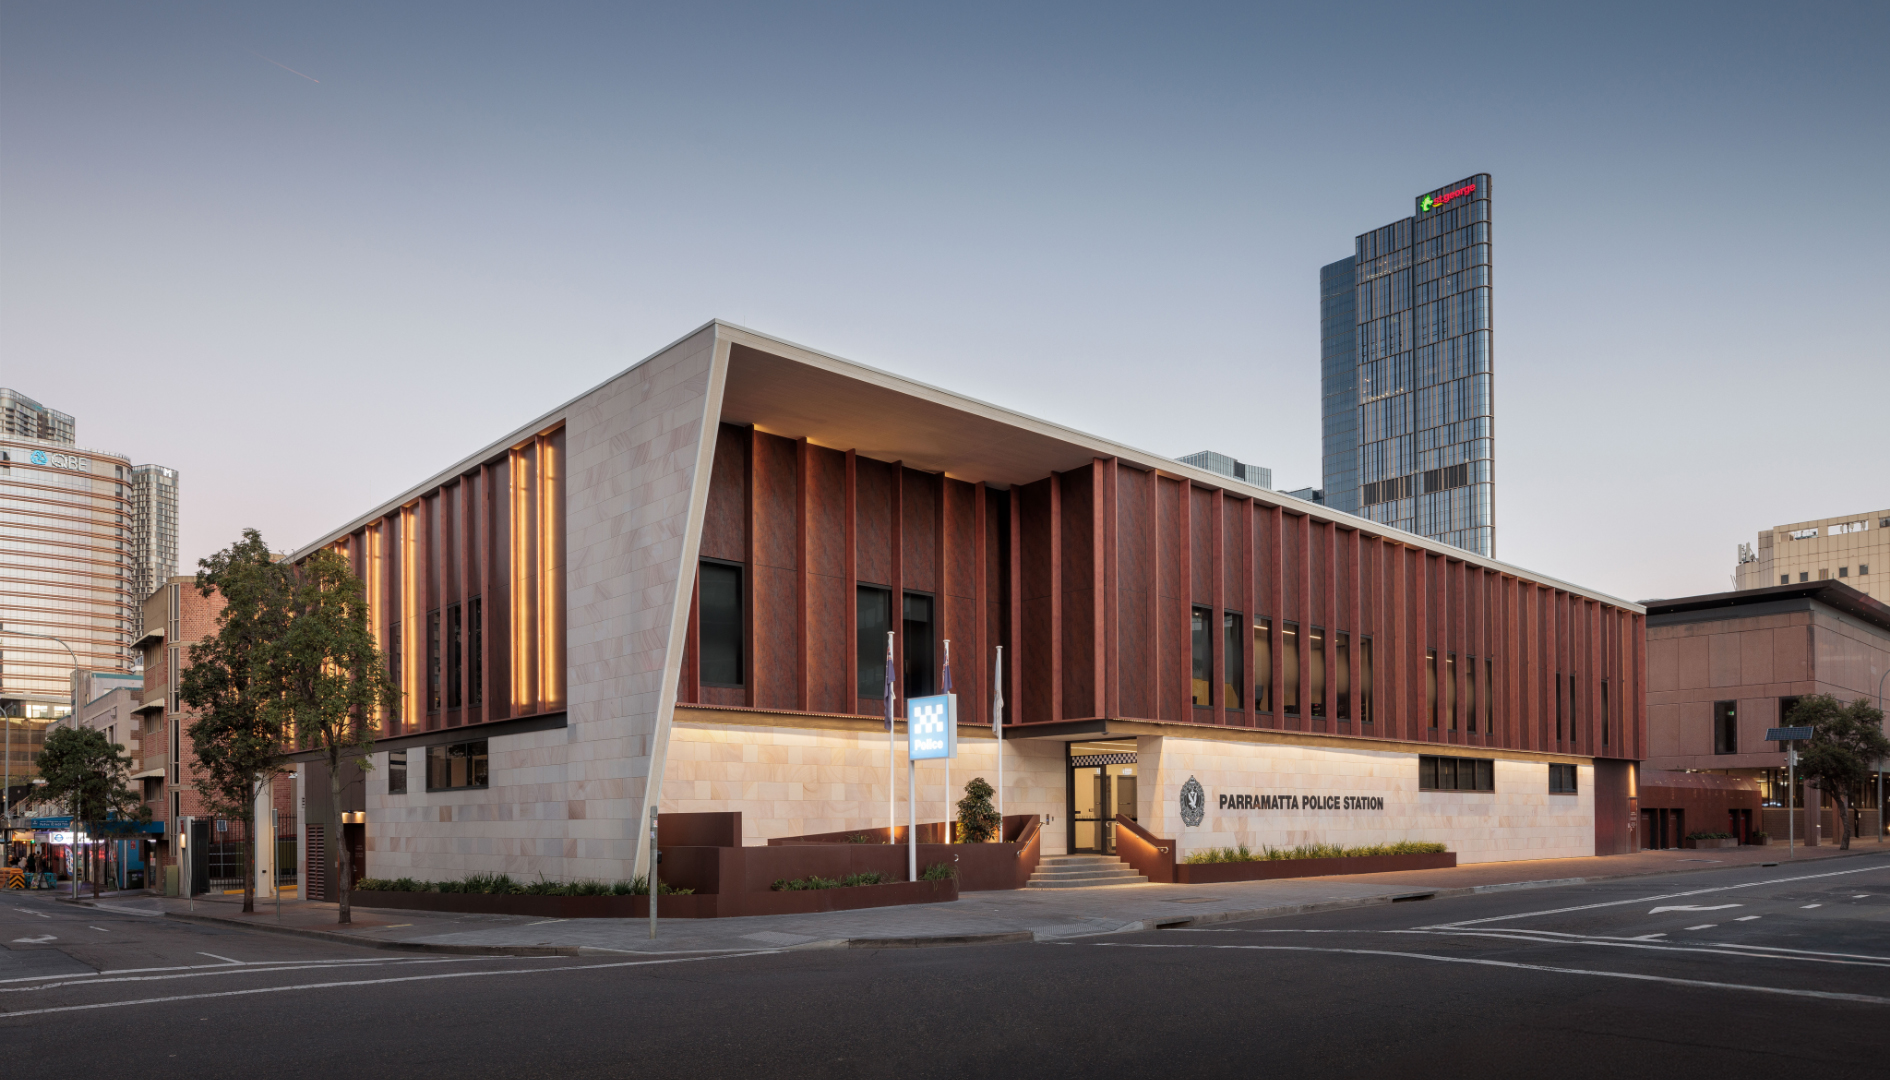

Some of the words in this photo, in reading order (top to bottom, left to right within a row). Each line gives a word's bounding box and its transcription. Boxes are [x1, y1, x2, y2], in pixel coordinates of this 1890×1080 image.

[51, 453, 88, 472] QBE
[163, 468, 172, 478] M
[914, 738, 943, 751] Police
[1219, 794, 1299, 810] PARRAMATTA
[1302, 795, 1340, 810] POLICE
[1343, 796, 1384, 810] STATION
